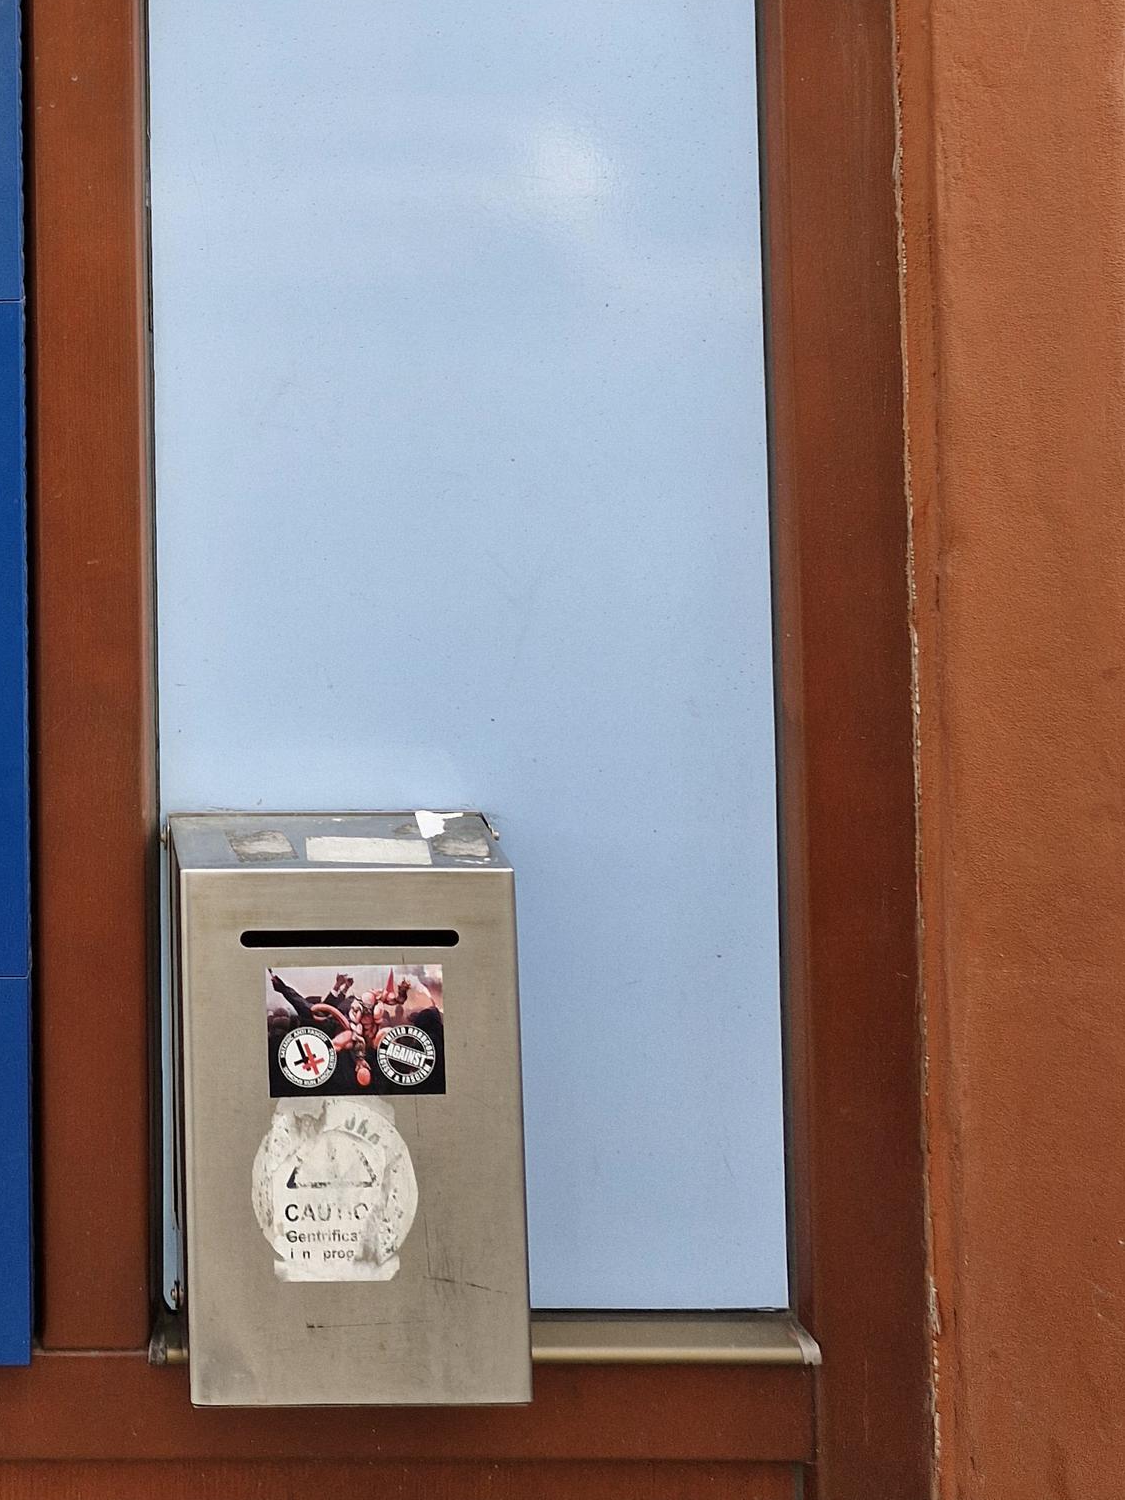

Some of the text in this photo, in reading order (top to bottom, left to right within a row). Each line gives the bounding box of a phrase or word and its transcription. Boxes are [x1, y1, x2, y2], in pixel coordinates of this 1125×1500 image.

[382, 1026, 434, 1060] UNITED HARDCORE
[386, 1043, 427, 1068] AGAINST
[379, 1048, 395, 1078] RACISM
[401, 1063, 432, 1084] FASCISM
[286, 1230, 361, 1243] Gentrifica
